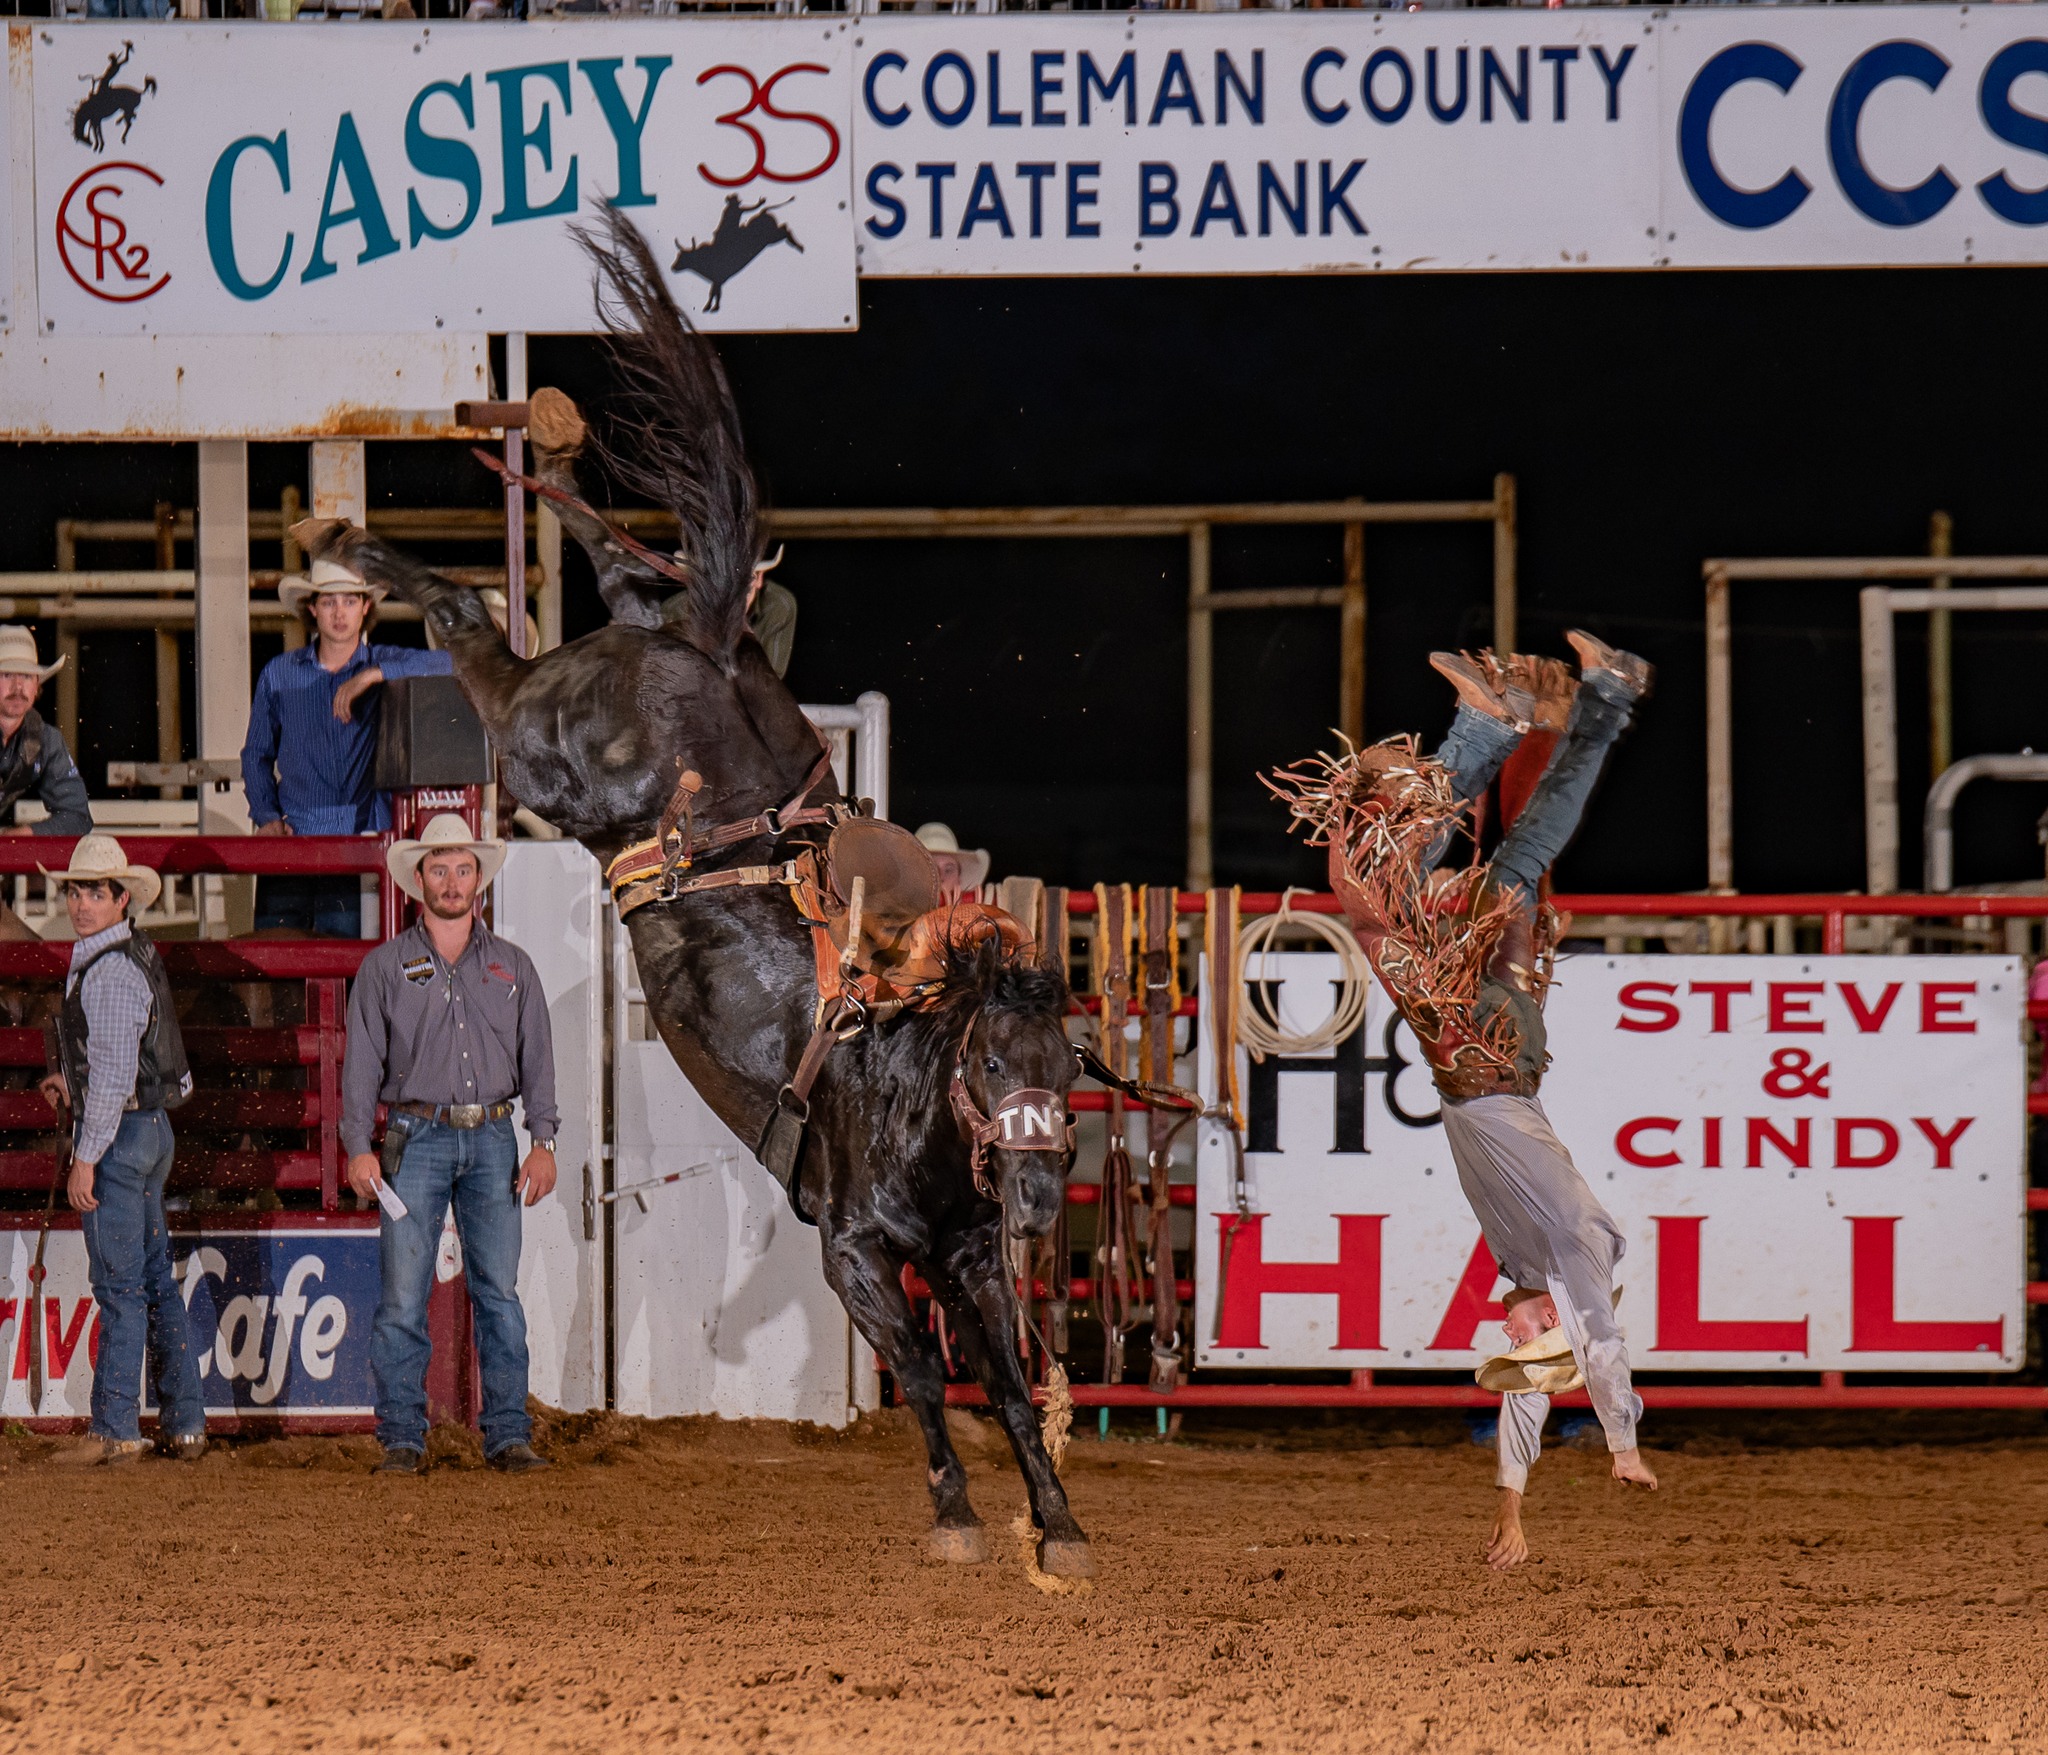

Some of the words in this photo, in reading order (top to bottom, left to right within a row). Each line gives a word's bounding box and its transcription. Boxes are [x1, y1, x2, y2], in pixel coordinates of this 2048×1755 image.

[862, 48, 1266, 129] COLEMAN
[1300, 44, 1639, 125] COUNTY
[1676, 36, 2048, 231] CCS
[204, 54, 674, 302] CASEY
[863, 160, 1104, 240] STATE
[1138, 157, 1370, 238] BANK
[1615, 980, 1979, 1034] STEVE
[1760, 1046, 1832, 1100] &
[1614, 1115, 1976, 1169] CINDY
